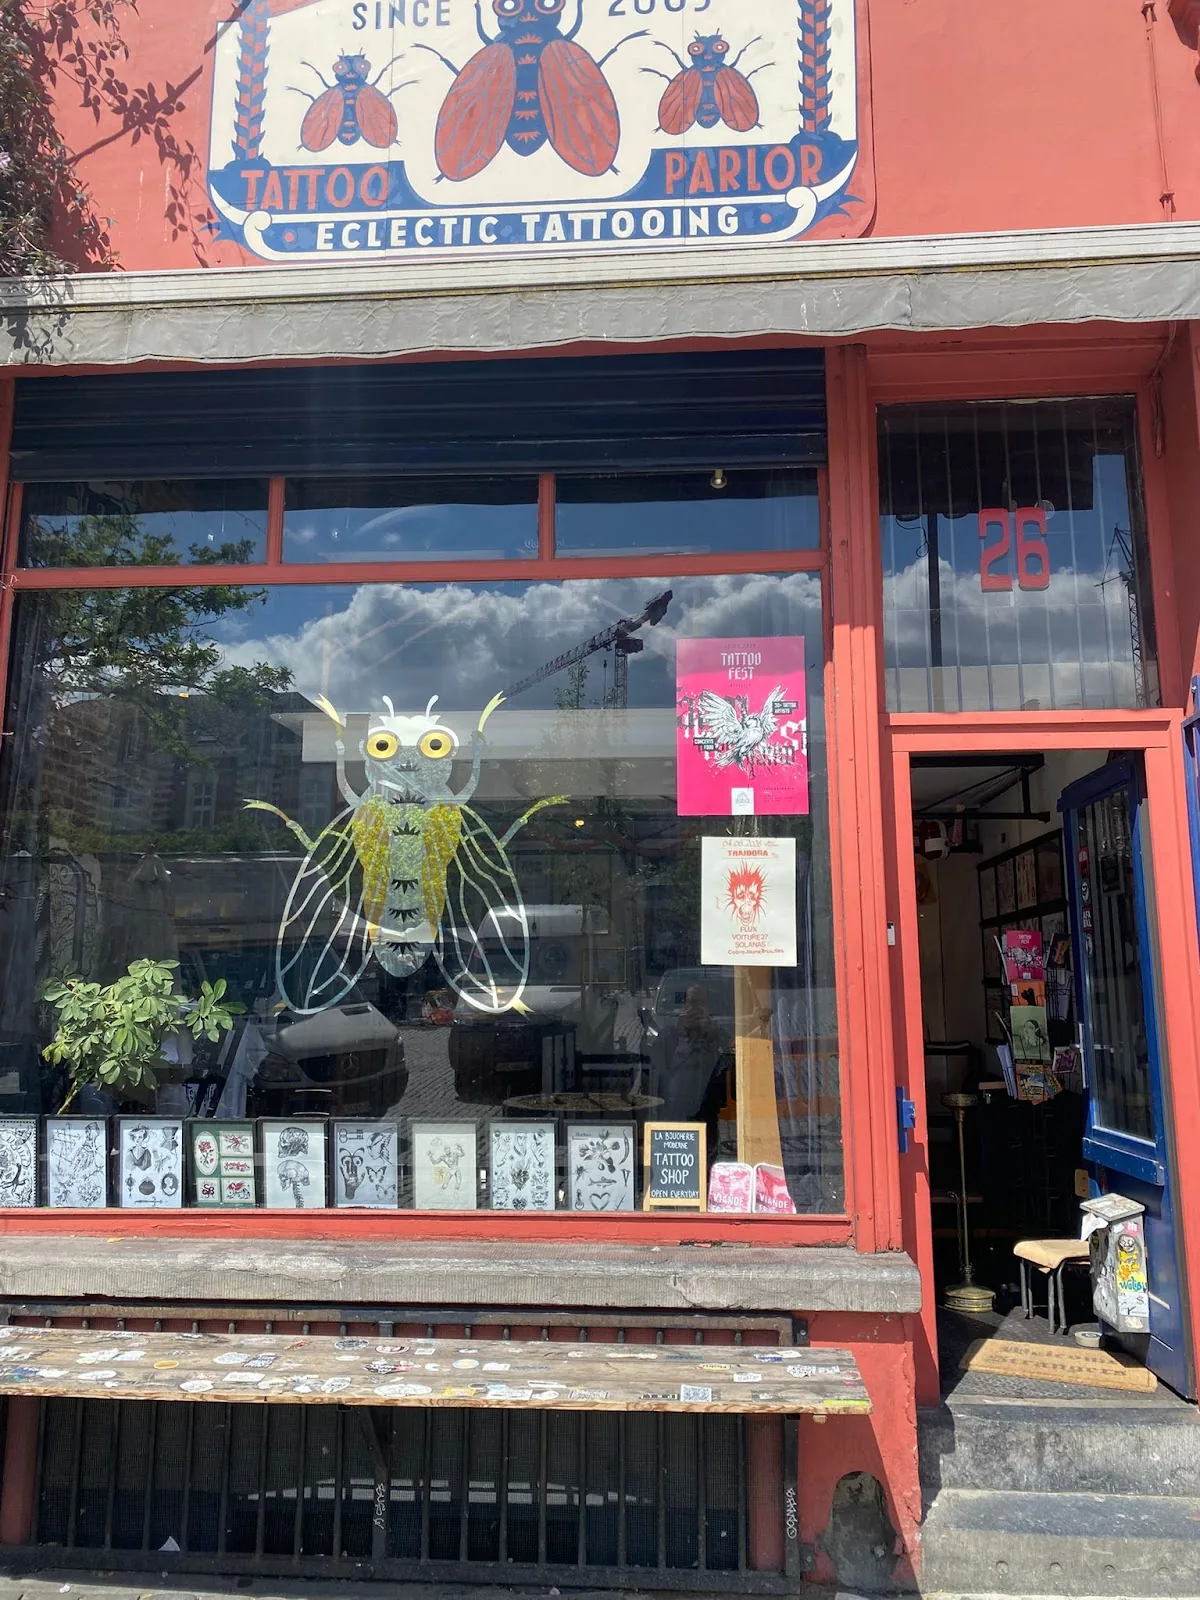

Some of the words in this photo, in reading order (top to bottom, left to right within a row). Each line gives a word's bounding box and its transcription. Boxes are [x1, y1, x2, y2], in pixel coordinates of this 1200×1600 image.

[352, 0, 450, 30] SINCE
[665, 145, 823, 194] PARLOR
[240, 165, 389, 210] TATTOO
[316, 216, 499, 250] ECLECTIC
[521, 205, 739, 242] TATTOOING
[978, 507, 1050, 592] 26
[720, 652, 761, 666] TATTOO
[728, 666, 755, 680] FEST
[654, 1132, 663, 1140] LA
[665, 1132, 695, 1141] BOUCHERIE
[663, 1141, 688, 1149] MODERNE
[654, 1153, 694, 1166] TATTOO
[660, 1169, 690, 1185] SHOP
[651, 1190, 668, 1198] OPEN
[670, 1190, 700, 1199] EVERYDAY
[713, 1192, 744, 1206] VIANDE
[759, 1193, 789, 1209] VIANDE
